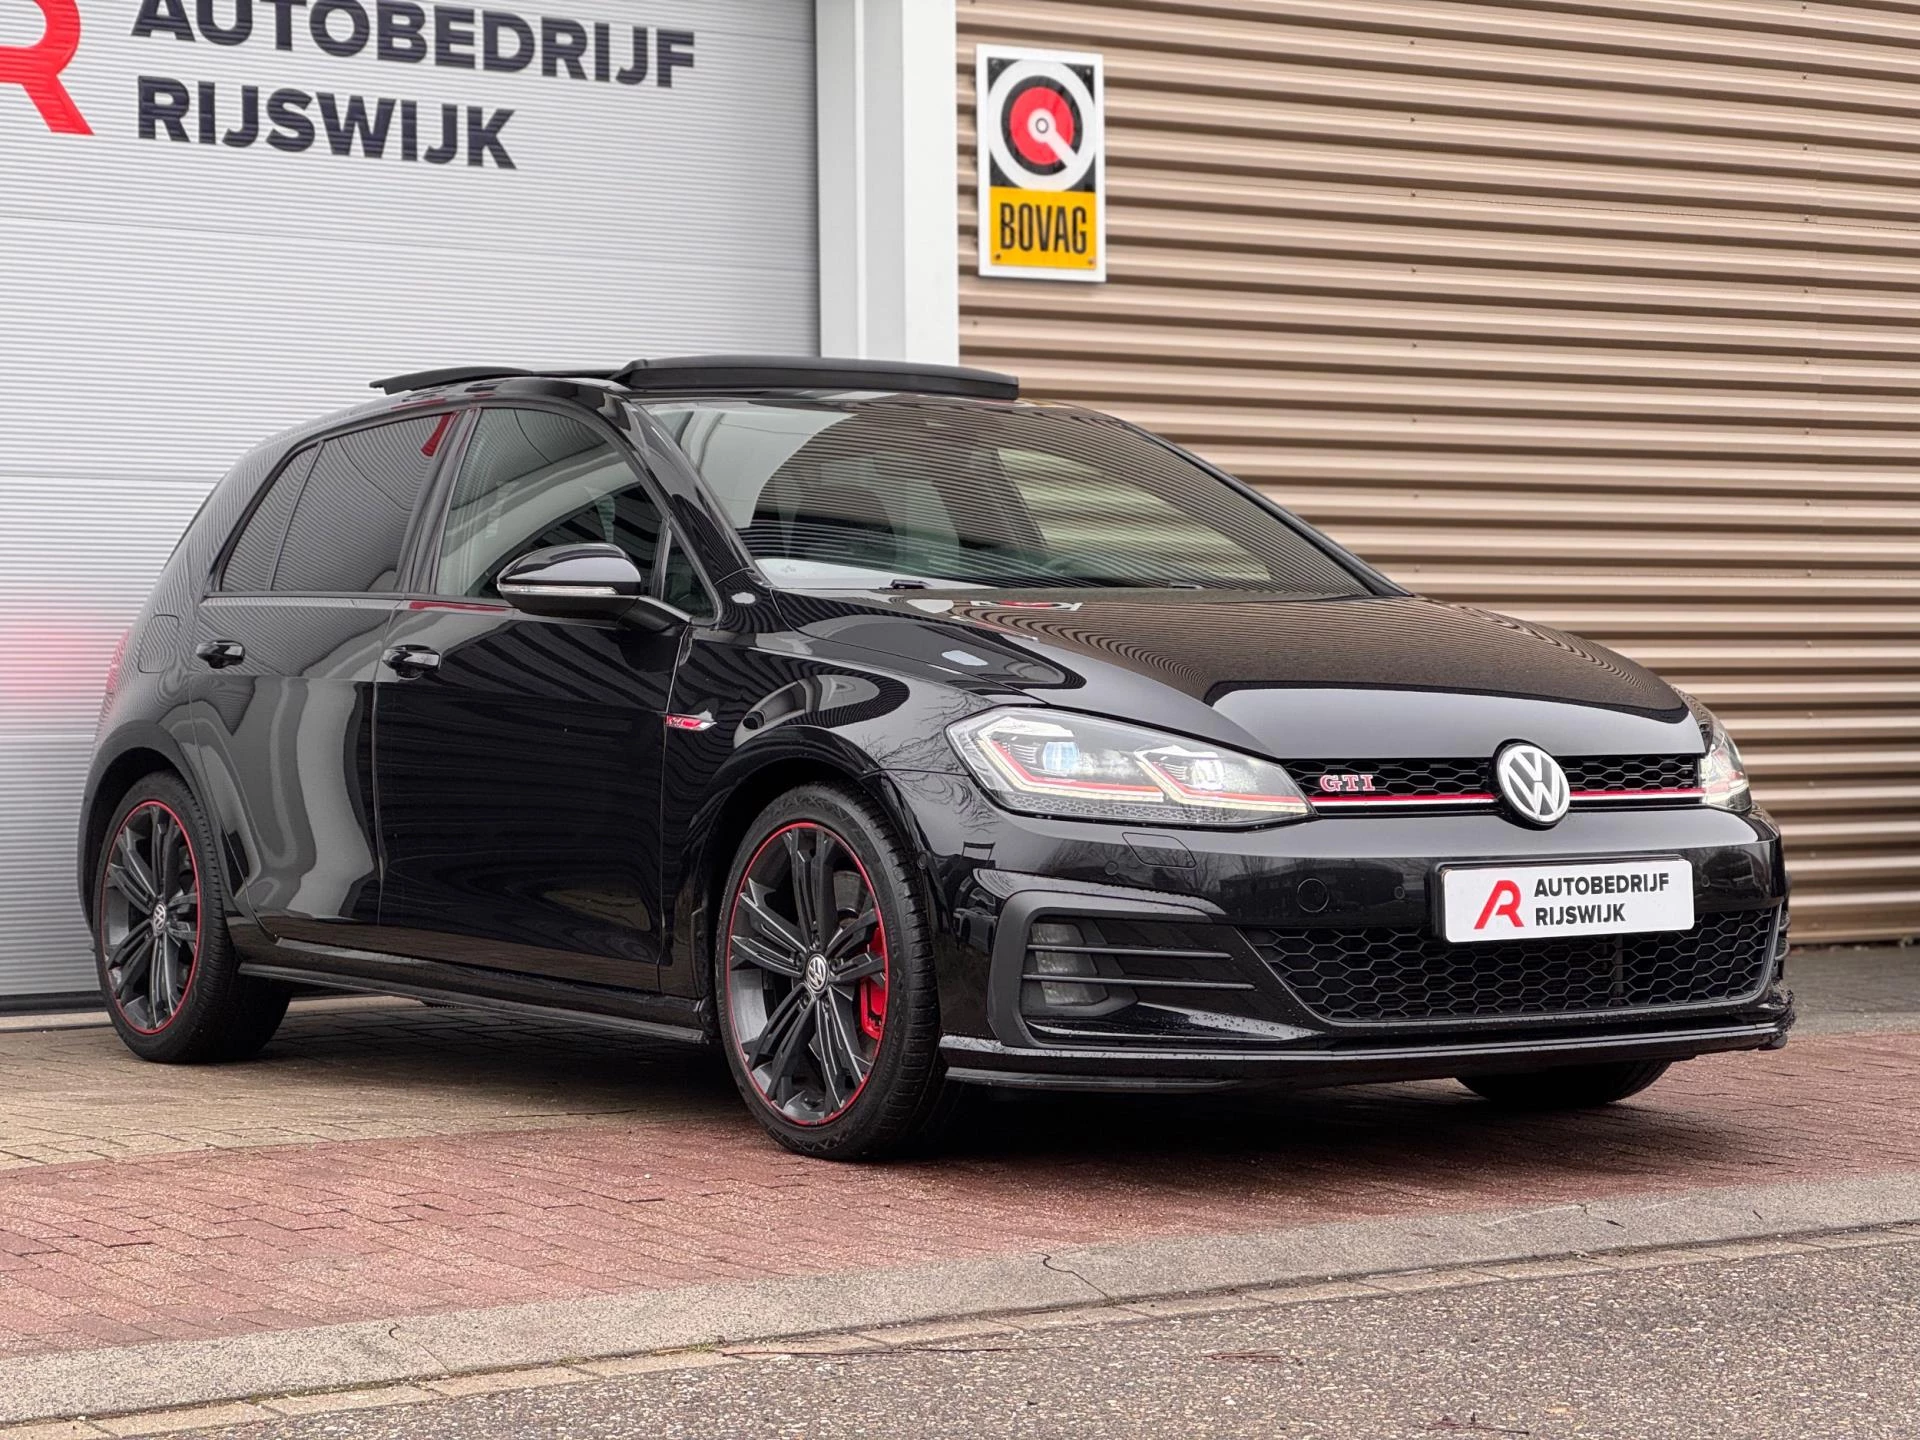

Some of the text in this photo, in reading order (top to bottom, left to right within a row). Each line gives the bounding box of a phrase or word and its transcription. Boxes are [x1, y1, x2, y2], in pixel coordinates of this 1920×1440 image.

[131, 0, 695, 88] AUTOBEDRIJF
[137, 75, 517, 169] RIJSWIJK
[1000, 202, 1087, 254] BOVAG
[1319, 774, 1376, 792] GTI
[1534, 873, 1669, 898] AUTOBEDRIJF
[1535, 903, 1626, 926] RIJSWIJK
